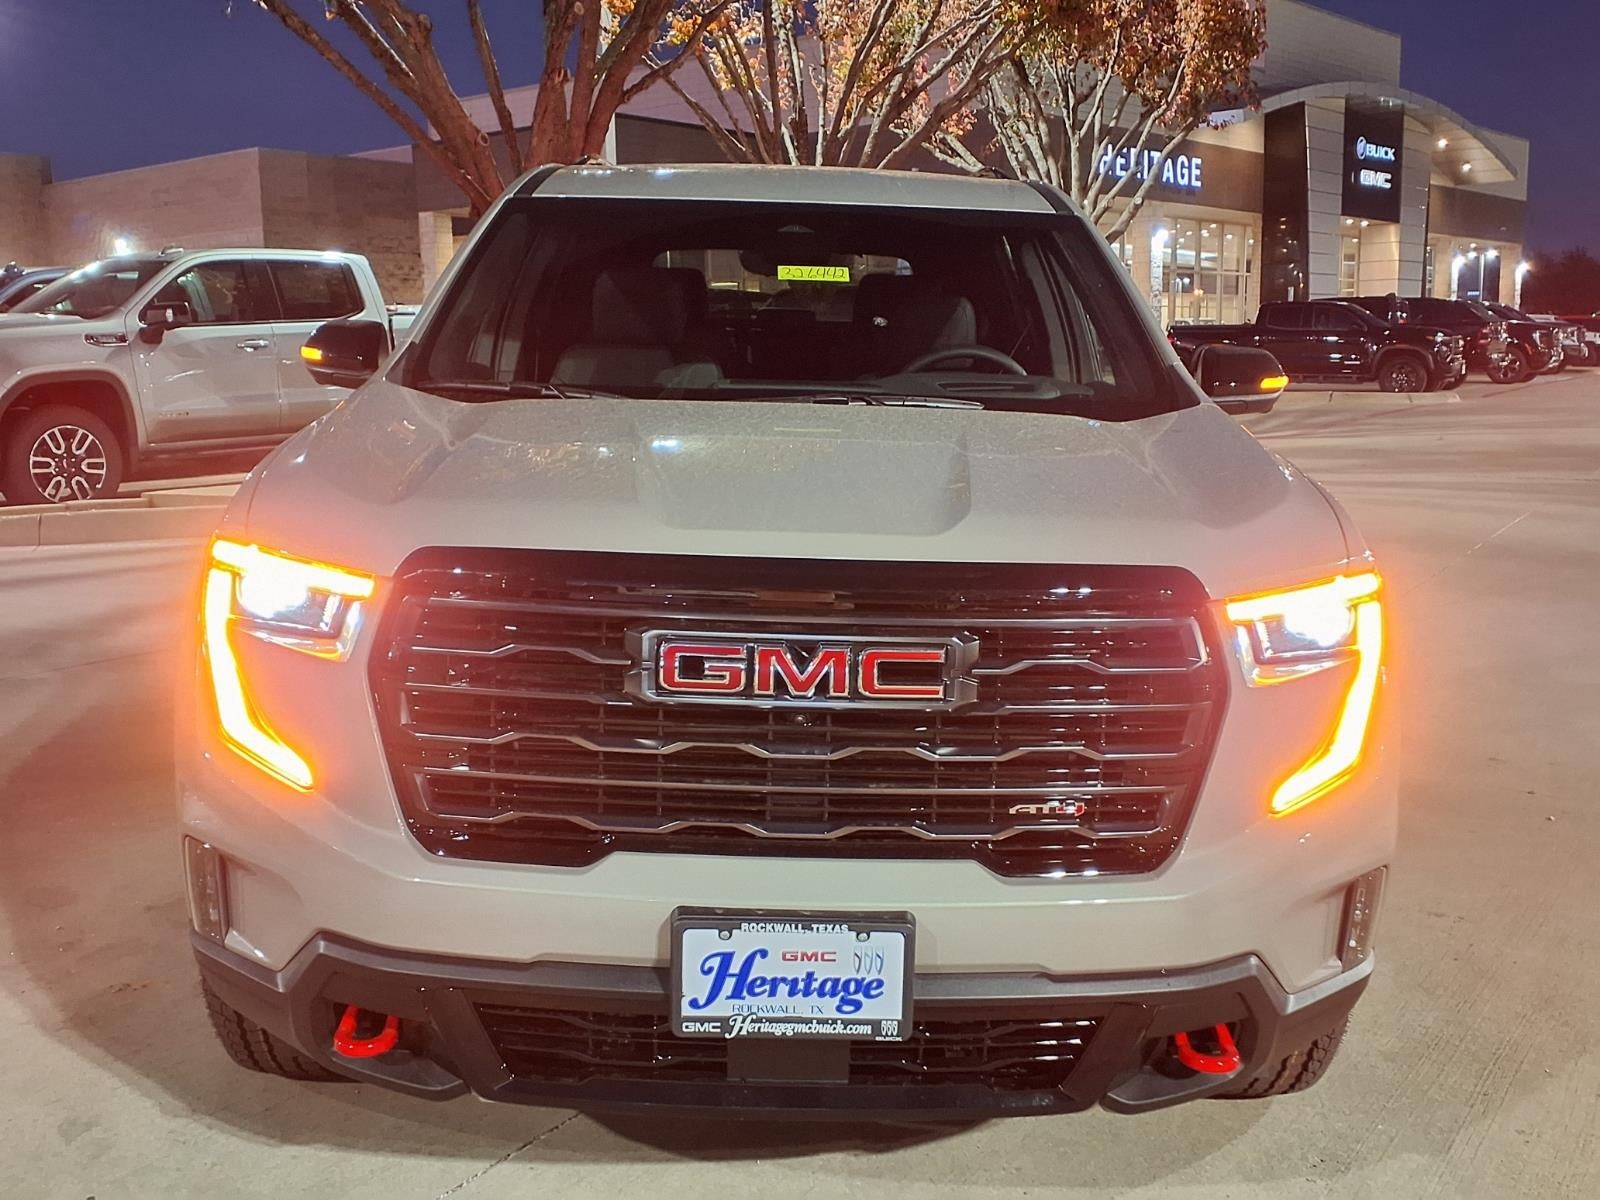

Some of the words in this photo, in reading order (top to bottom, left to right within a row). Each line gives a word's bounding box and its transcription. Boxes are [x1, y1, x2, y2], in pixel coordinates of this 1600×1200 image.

[1366, 143, 1396, 162] BUICK
[1360, 168, 1392, 189] GMC
[658, 641, 946, 700] GMC
[741, 922, 808, 935] ROCKWALL,
[811, 923, 849, 935] TEXAS
[781, 951, 837, 962] GMC
[687, 948, 885, 1015] Heritage
[810, 1004, 825, 1015] TX
[682, 1022, 722, 1033] GMC
[724, 1014, 873, 1040] Heritagegmcbuick.com
